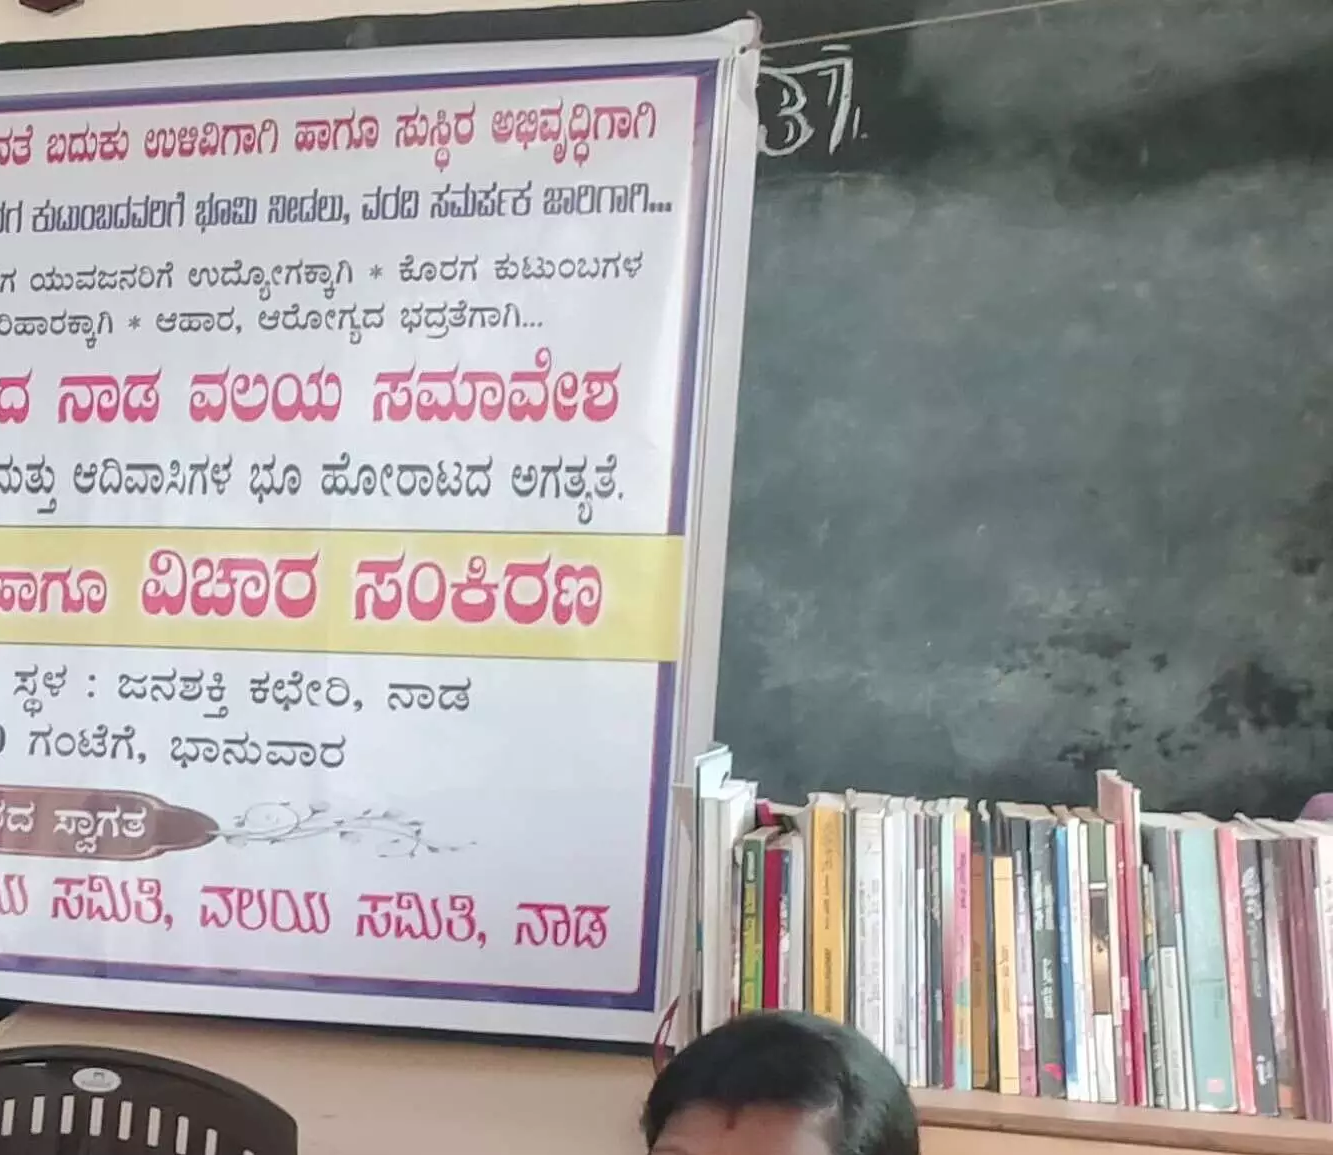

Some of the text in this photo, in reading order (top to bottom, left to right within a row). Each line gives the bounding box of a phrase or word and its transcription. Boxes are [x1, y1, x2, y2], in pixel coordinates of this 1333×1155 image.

[46, 121, 129, 164] ಬದುಕು
[144, 118, 278, 159] ಉಳಿವಿಗಾಗಿ
[294, 107, 379, 151] ಹಾಗೂ
[395, 102, 475, 172] ಸುಸ್ಥಿರ
[491, 96, 656, 168] ಅಭಿವೃದ್ಧಿಗಾಗಿ
[32, 191, 185, 233] ಕುಟುಂಬದವರಿಗೆ
[195, 191, 257, 234] ಭೂಮಿ
[268, 188, 350, 224] ನೀಡಲು,
[362, 185, 419, 220] ವರದಿ
[30, 261, 175, 293] ಯುವಜನರಿಗೆ
[188, 258, 353, 301] ಉದ್ಯೋಗಕ್ಕಾಗಿ
[399, 253, 478, 283] ಕೊರಗ
[494, 250, 644, 281] ಕುಟುಂಬಗಳ
[156, 306, 242, 335] ಆಹಾರ,
[257, 302, 385, 345] ಆರೋಗ್ಯದ
[57, 365, 162, 424] ನಾಡ
[189, 362, 343, 424] ವಲಯ
[372, 346, 623, 424] ಸಮಾವೇಶ
[73, 453, 234, 498] ಆದಿವಾಸಿಗಳ
[249, 454, 301, 504] ಭೂ
[321, 452, 493, 498] ಹೋರಾಟದ
[511, 453, 623, 525] ಅಗತ್ಯತೆ.
[140, 548, 321, 620] ವಿಚಾರ
[352, 551, 604, 627] ಸಂಕಿರಣ
[13, 663, 68, 717] ಸ್ಥಳ
[119, 667, 229, 718] ಜನಶಕ್ತಿ
[249, 670, 363, 713] ಕಛೇರಿ,
[388, 676, 472, 712] ನಾಡ
[28, 721, 146, 764] ಗಂಟೆಗೆ,
[170, 731, 347, 769] ಭಾನುವಾರ
[53, 804, 148, 854] ಸ್ವಾಗತ
[51, 874, 174, 931] ಸಮಿತಿ,
[356, 891, 487, 949] ಸಮಿತಿ,
[514, 898, 611, 949] ನಾಡ
